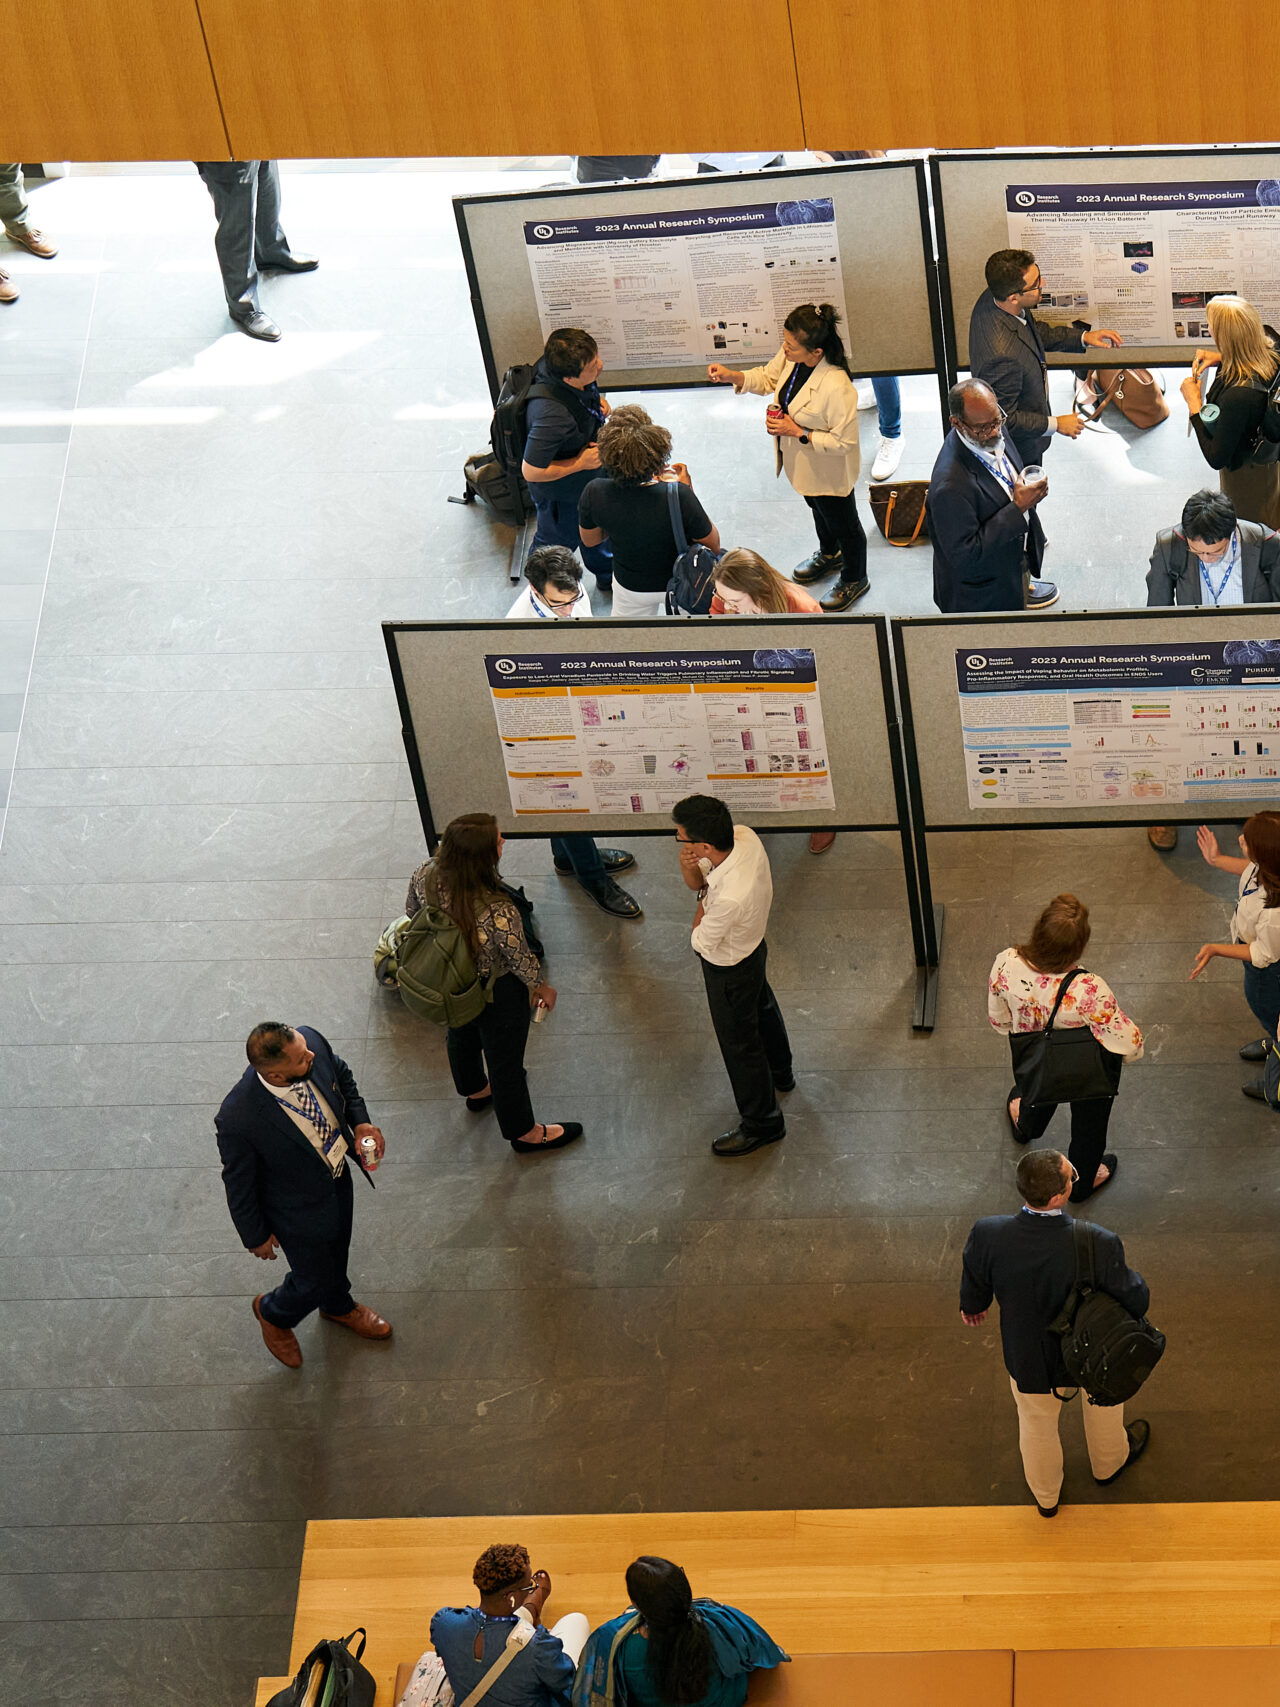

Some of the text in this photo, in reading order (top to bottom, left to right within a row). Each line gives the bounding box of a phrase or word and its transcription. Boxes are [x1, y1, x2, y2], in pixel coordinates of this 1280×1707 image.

[1140, 193, 1186, 201] Research
[1188, 192, 1245, 200] Symposium
[623, 220, 657, 230] Annual
[659, 217, 705, 228] Research
[708, 213, 765, 225] Symposium
[680, 658, 741, 668] Symposium
[1099, 655, 1147, 663] Research
[1150, 653, 1211, 663] Symposium
